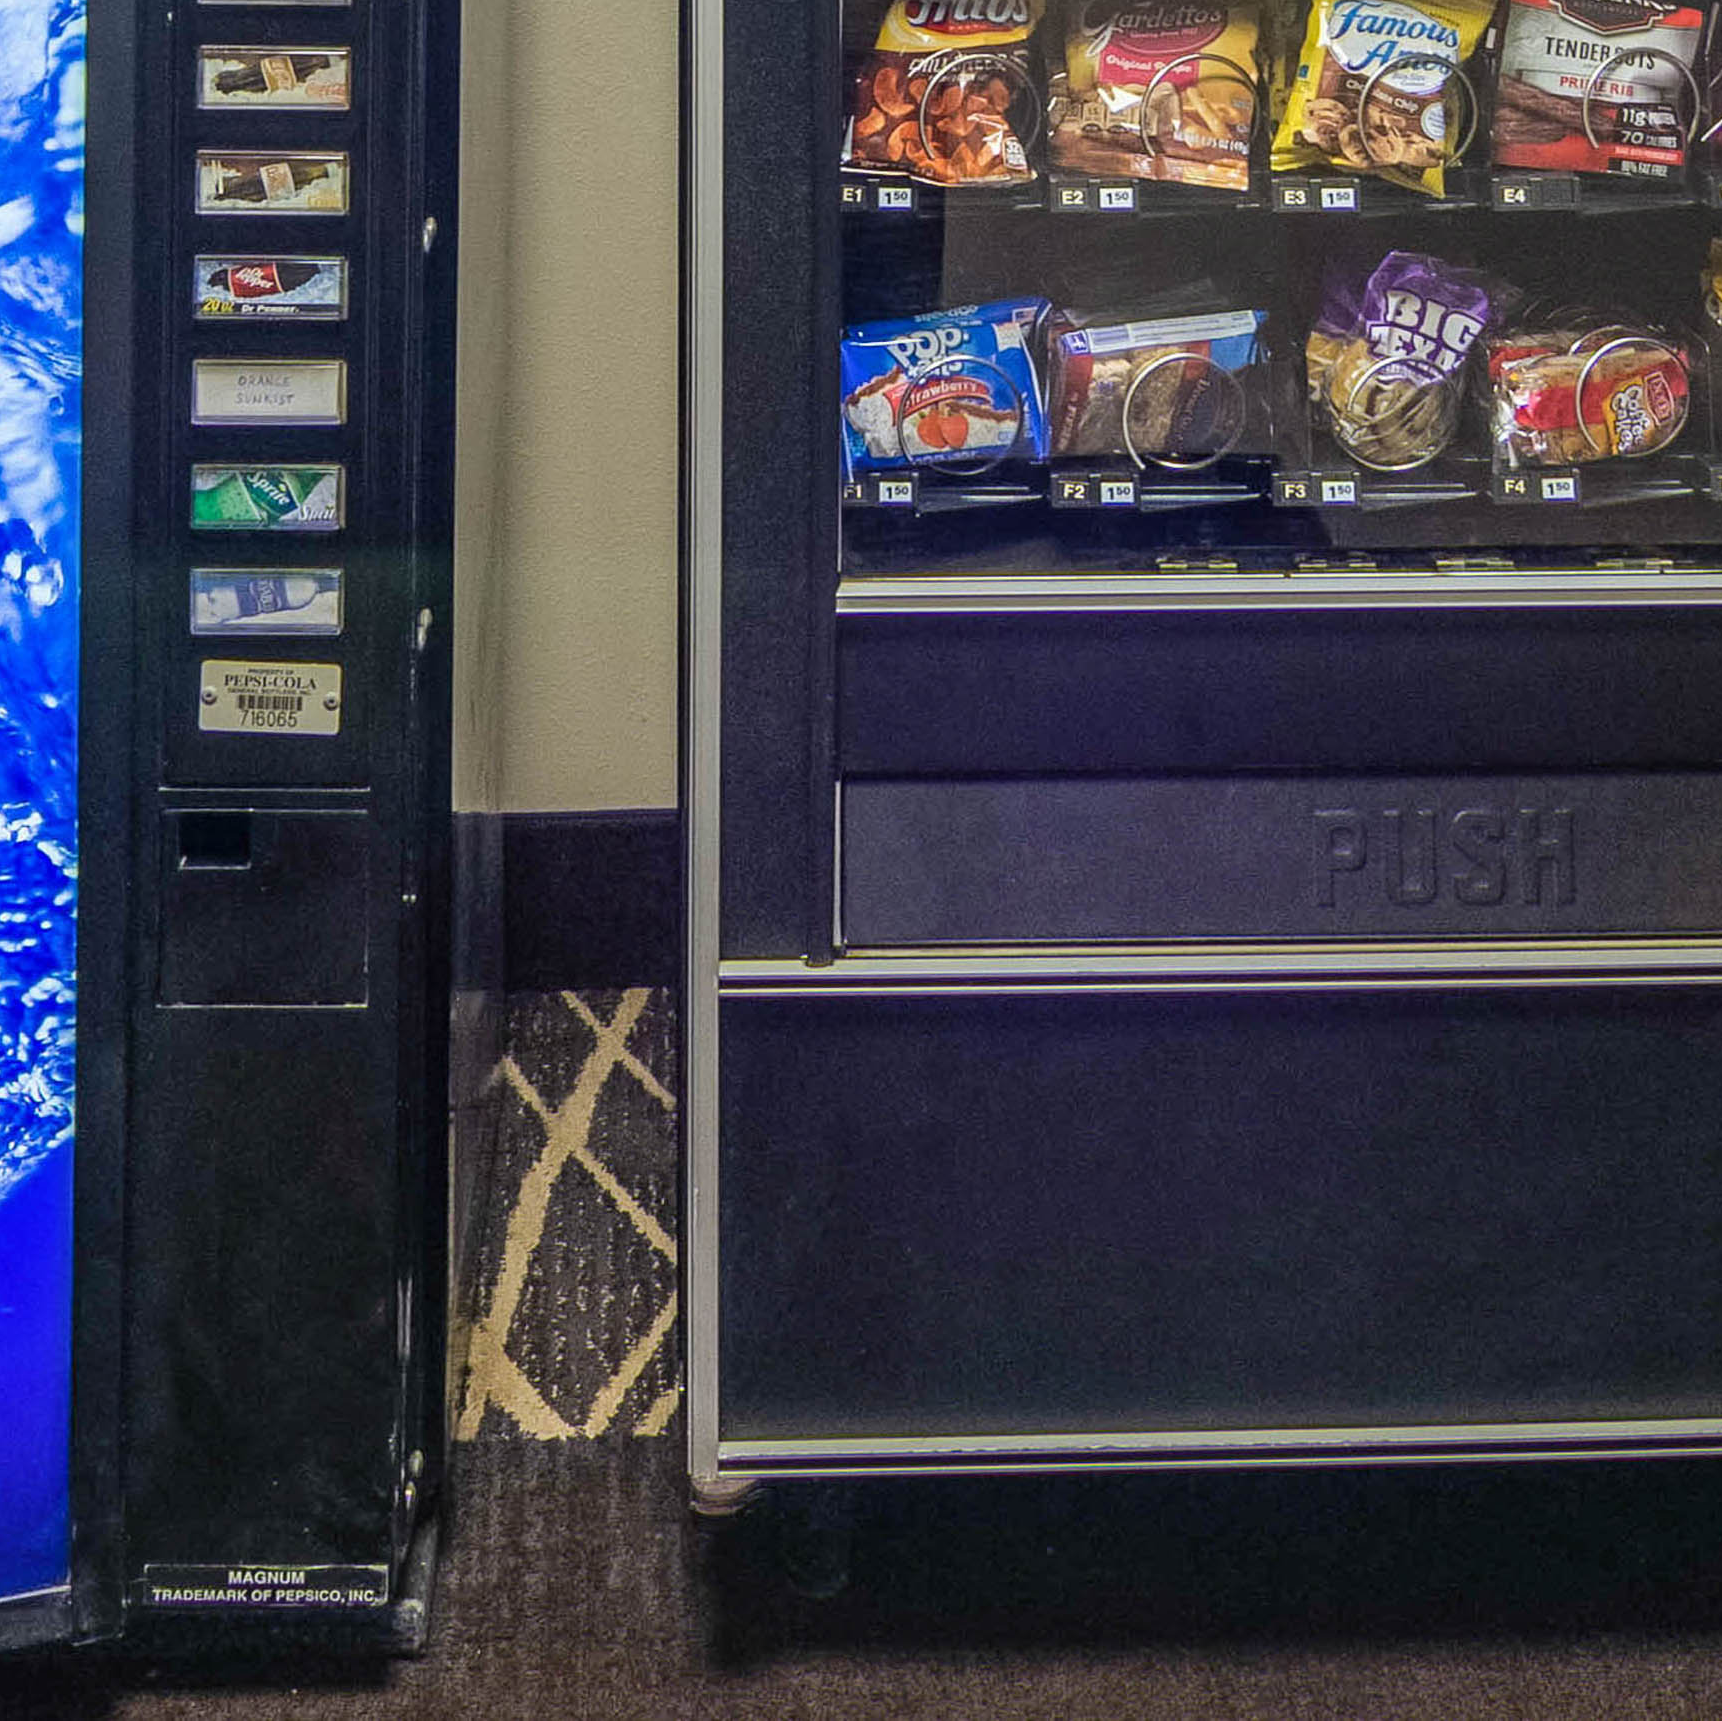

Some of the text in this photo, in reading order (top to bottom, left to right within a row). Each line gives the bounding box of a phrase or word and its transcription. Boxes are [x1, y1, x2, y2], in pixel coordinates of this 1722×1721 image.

[1545, 36, 1610, 63] TENDER
[1610, 81, 1634, 97] RIB
[1621, 130, 1644, 144] 70
[842, 188, 863, 203] E1
[1062, 191, 1084, 205] E2
[1284, 190, 1306, 204] E3
[1503, 190, 1526, 203] E4
[202, 298, 219, 312] 20
[1385, 290, 1485, 354] BIG
[844, 486, 862, 499] F1
[1063, 485, 1085, 499] F2
[1284, 485, 1306, 499] F3
[1504, 480, 1526, 494] F4
[224, 675, 317, 690] PEPSI-COLA
[240, 710, 298, 728] 716065
[1314, 808, 1576, 907] PUSH
[229, 1571, 306, 1584] MAGNUM
[153, 1589, 378, 1604] TRADEMARK OF PEPSICO, INC.
